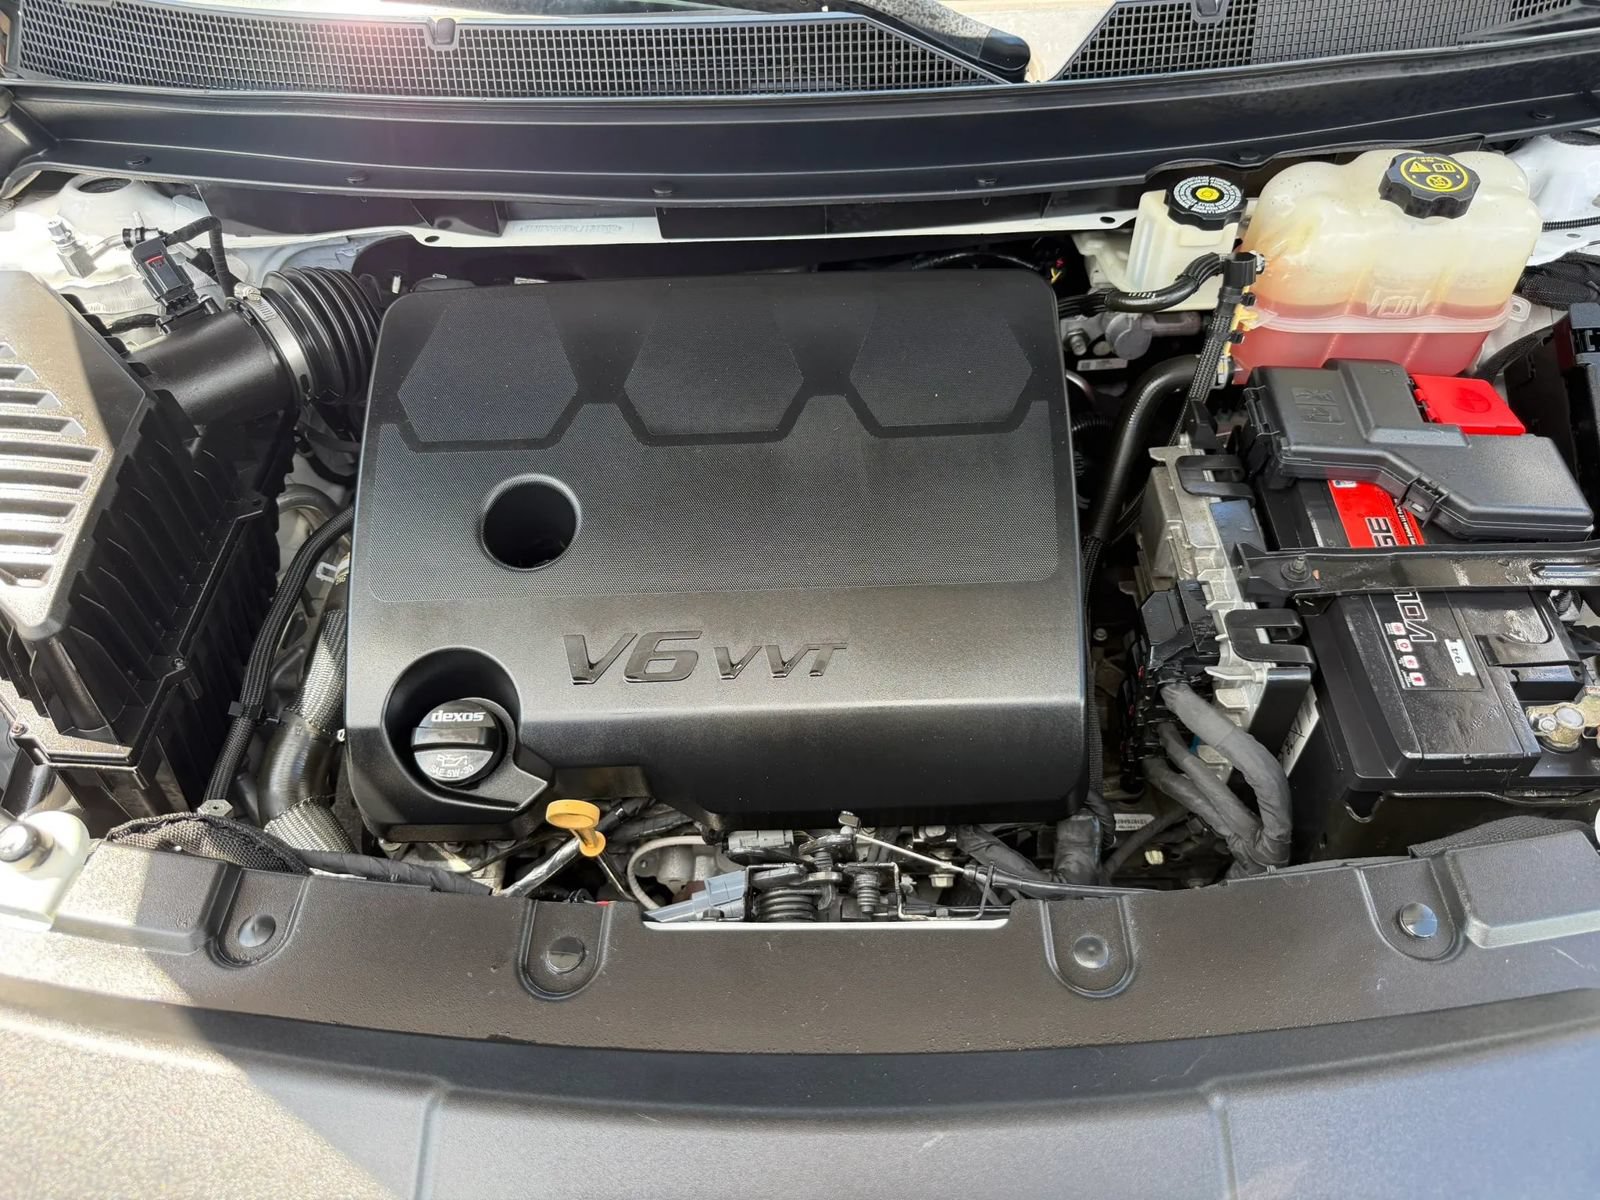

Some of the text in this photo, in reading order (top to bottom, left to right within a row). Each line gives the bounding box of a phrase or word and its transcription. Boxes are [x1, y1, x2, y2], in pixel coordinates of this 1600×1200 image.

[562, 630, 848, 685] V6 VVT
[431, 709, 487, 722] dexos
[430, 763, 474, 777] SAE 5W-30
